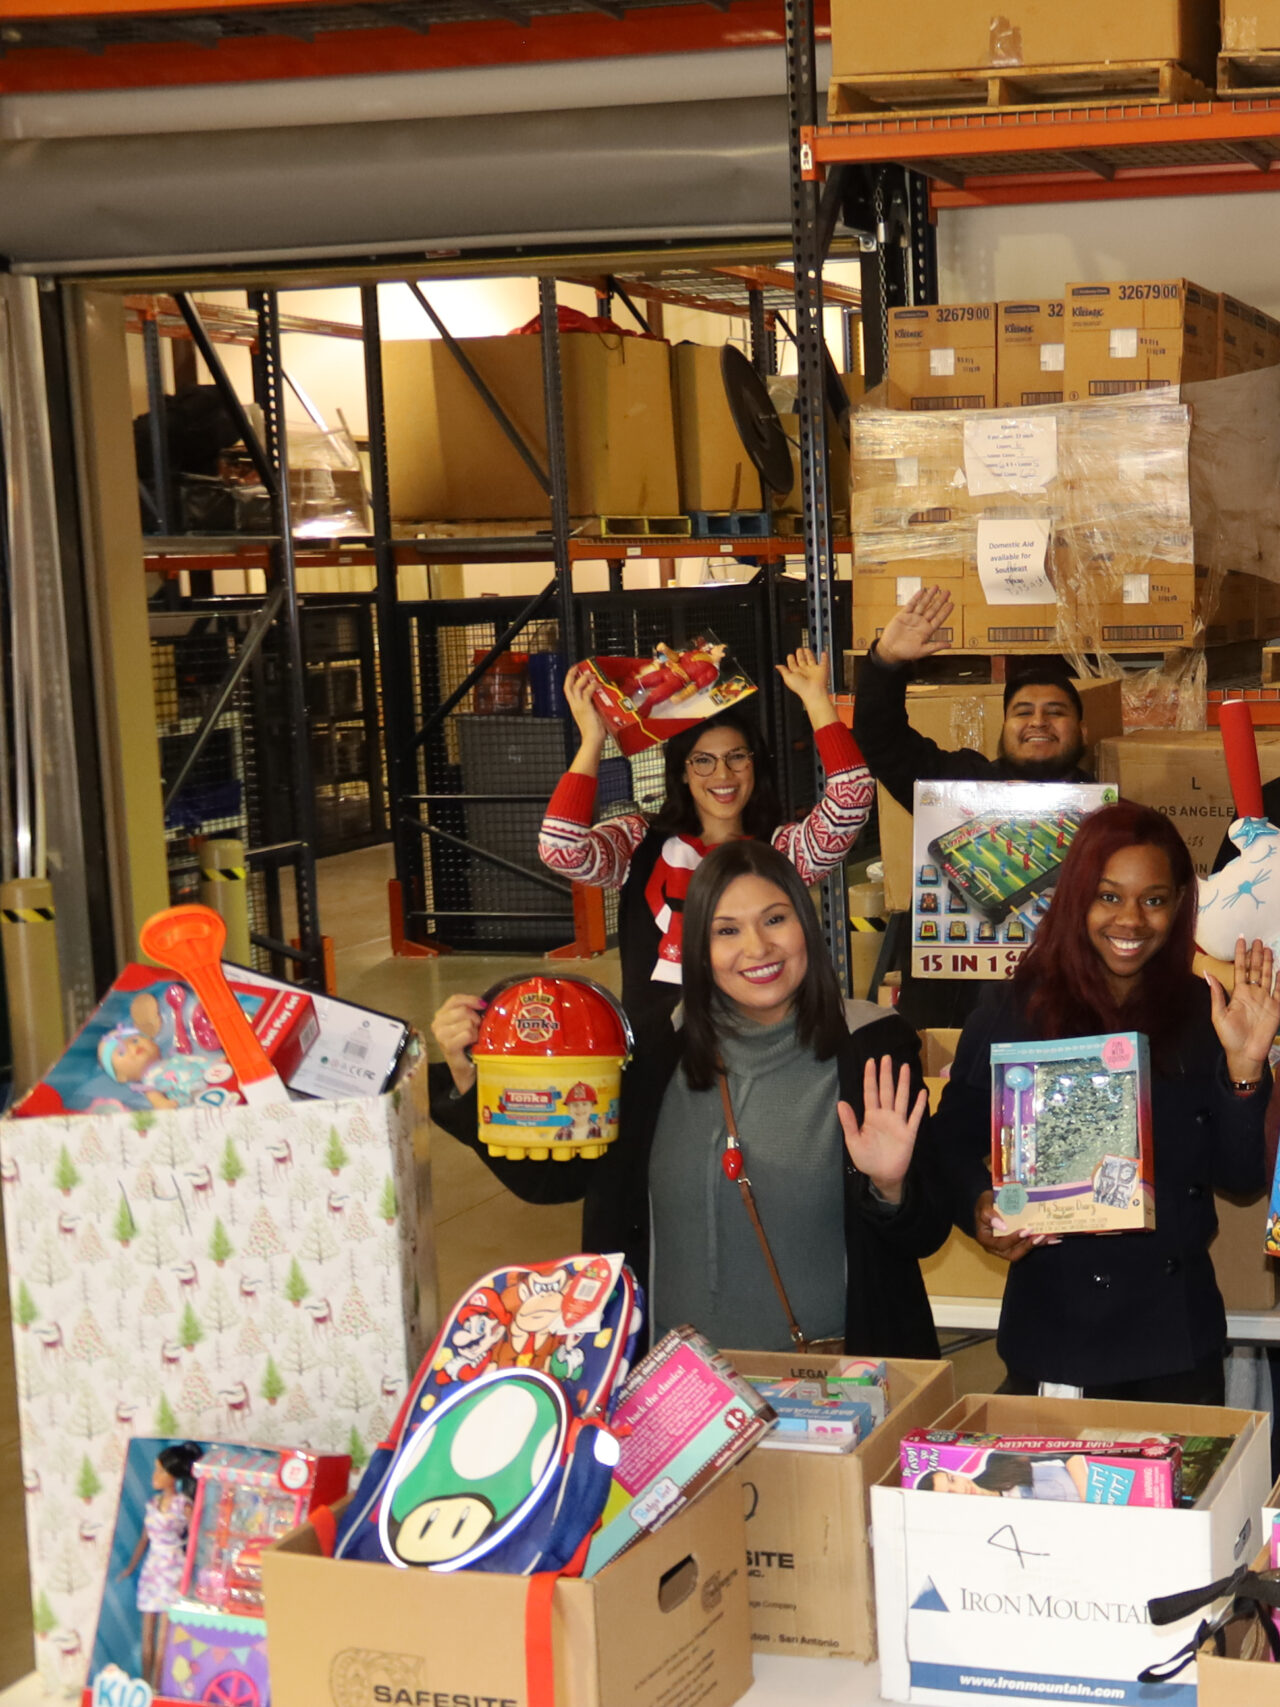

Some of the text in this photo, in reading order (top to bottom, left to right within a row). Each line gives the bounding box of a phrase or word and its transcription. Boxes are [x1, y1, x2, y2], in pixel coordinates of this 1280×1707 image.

[1180, 806, 1235, 818] ANGELE
[919, 954, 943, 973] 15
[952, 954, 978, 973] IN
[987, 955, 998, 973] 1
[517, 1018, 559, 1031] Tonka
[507, 1092, 549, 1103] Tonka
[960, 1587, 1153, 1625] IRON MOUNTAI
[778, 1633, 799, 1644] San
[800, 1635, 840, 1648] Antonio
[959, 1673, 1126, 1700] www.ironmountain.com
